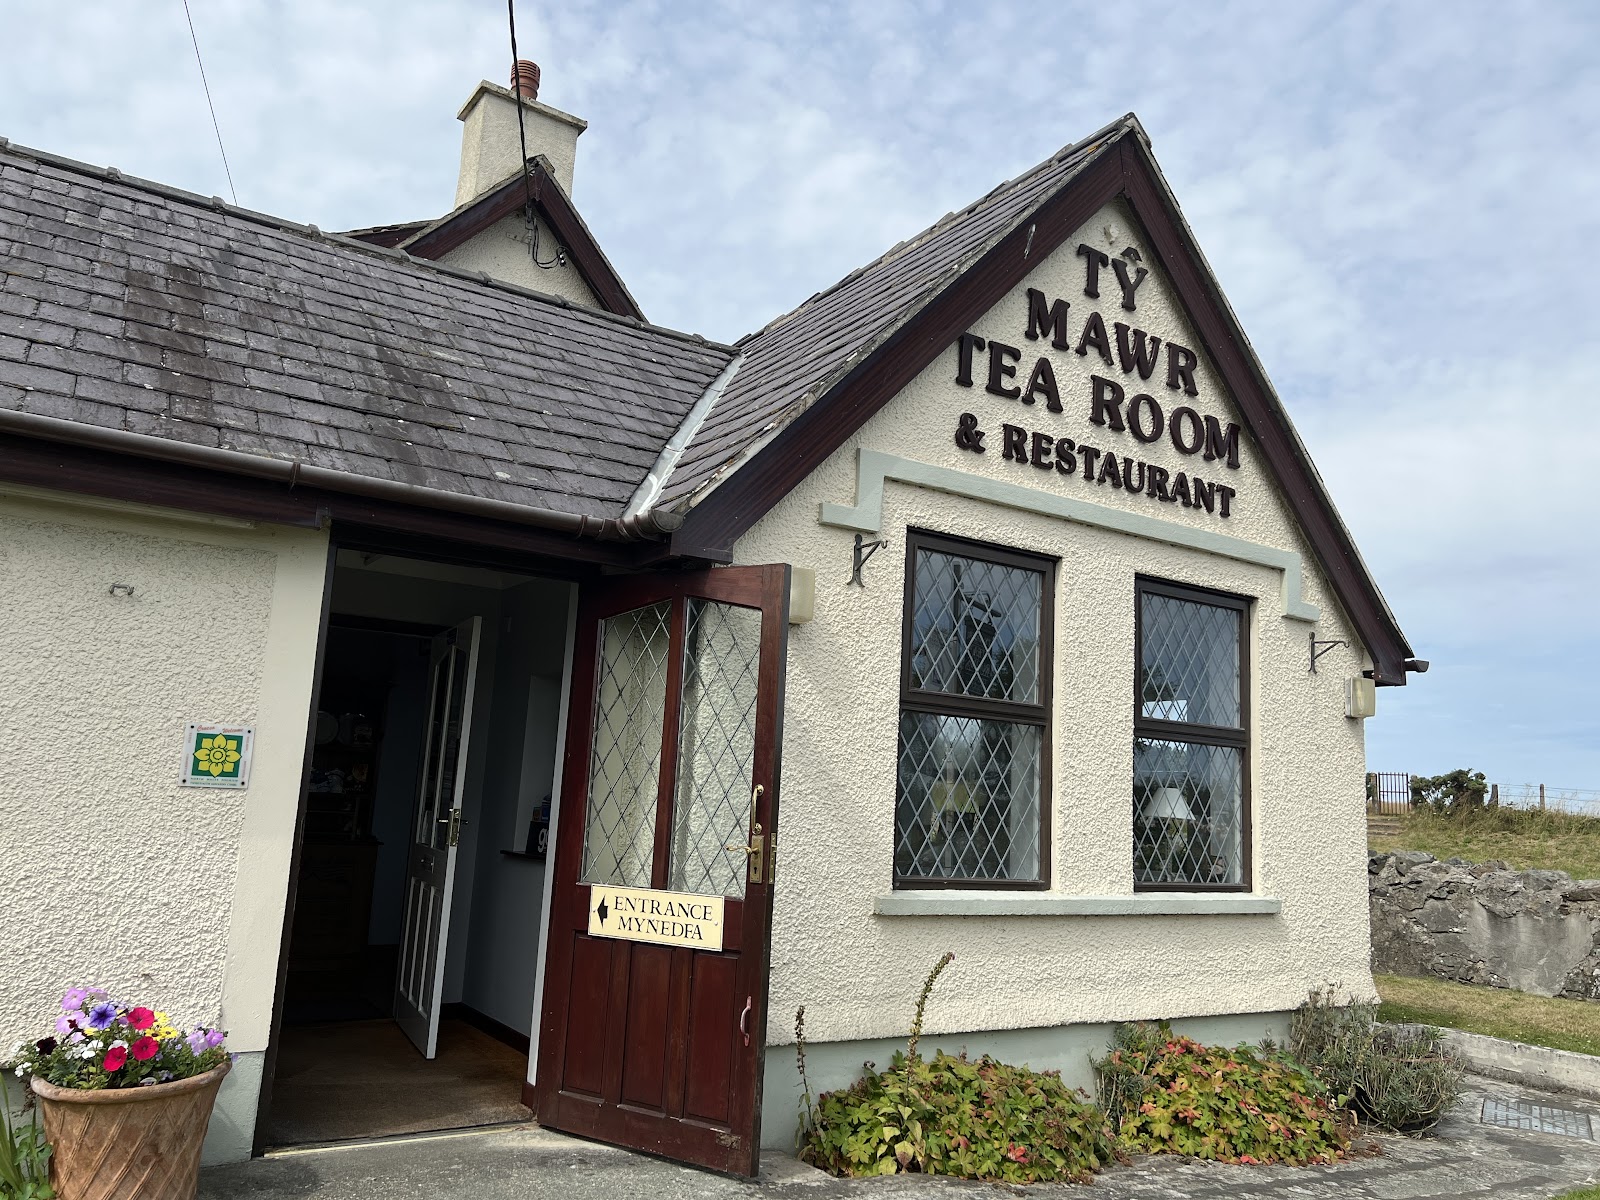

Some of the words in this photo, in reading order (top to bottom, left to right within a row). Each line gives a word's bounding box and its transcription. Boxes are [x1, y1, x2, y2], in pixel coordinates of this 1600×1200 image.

[1025, 287, 1198, 397] MAWR
[956, 331, 1063, 413] TEA
[1090, 374, 1241, 469] ROOM
[955, 412, 986, 454] &
[1002, 423, 1236, 518] RESTAURANT
[613, 895, 713, 922] ENTRANCE
[617, 915, 703, 941] MYNEDFA
